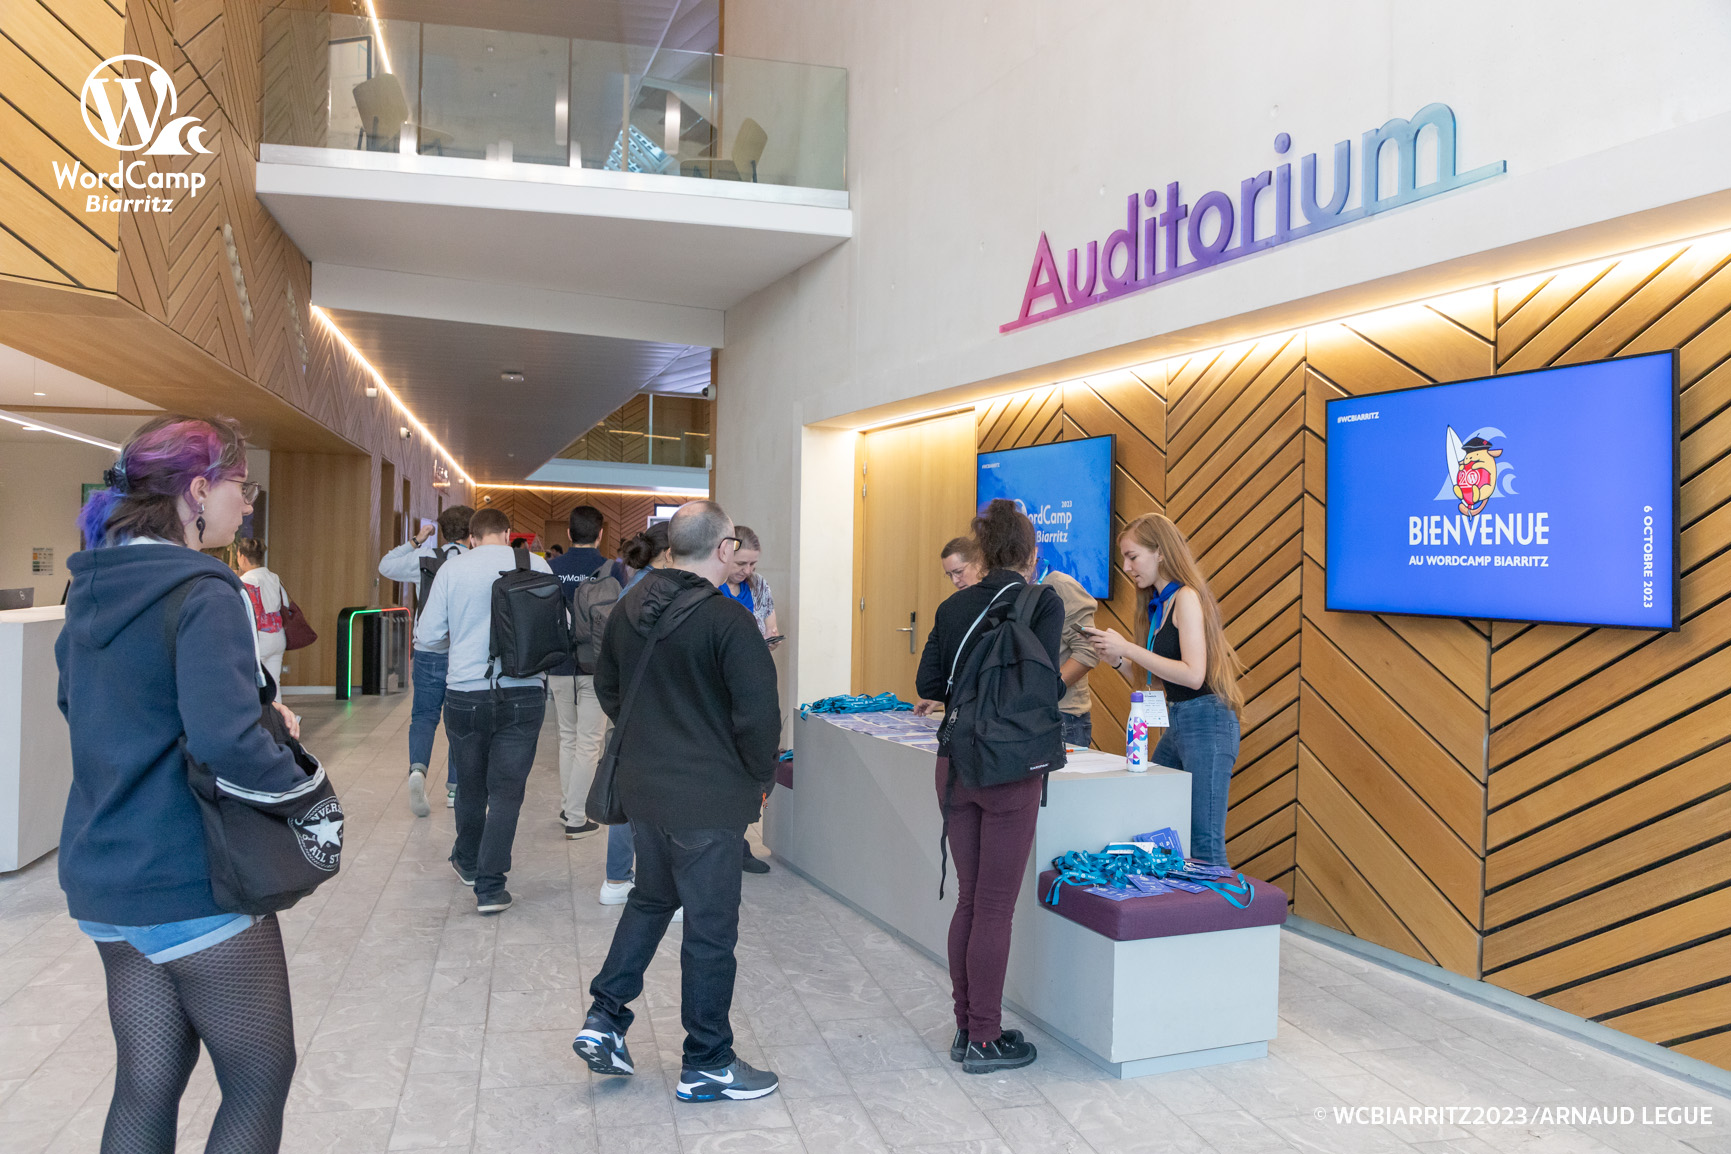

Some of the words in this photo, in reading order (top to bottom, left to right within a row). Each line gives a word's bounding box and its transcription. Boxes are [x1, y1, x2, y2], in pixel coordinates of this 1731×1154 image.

[1001, 102, 1506, 333] Auditorium
[1337, 411, 1380, 424] #WCBIARRITZ
[1028, 505, 1072, 529] ordCamp
[1643, 505, 1653, 513] 6
[1036, 530, 1068, 542] Biarritz
[1408, 511, 1550, 546] BIENVENUE
[1643, 515, 1653, 578] OCTOBRE
[1408, 555, 1424, 566] AU
[1425, 555, 1491, 567] WORDCAMP
[1493, 555, 1549, 567] BIARRITZ
[1643, 580, 1653, 608] 2023
[309, 845, 327, 863] ALL
